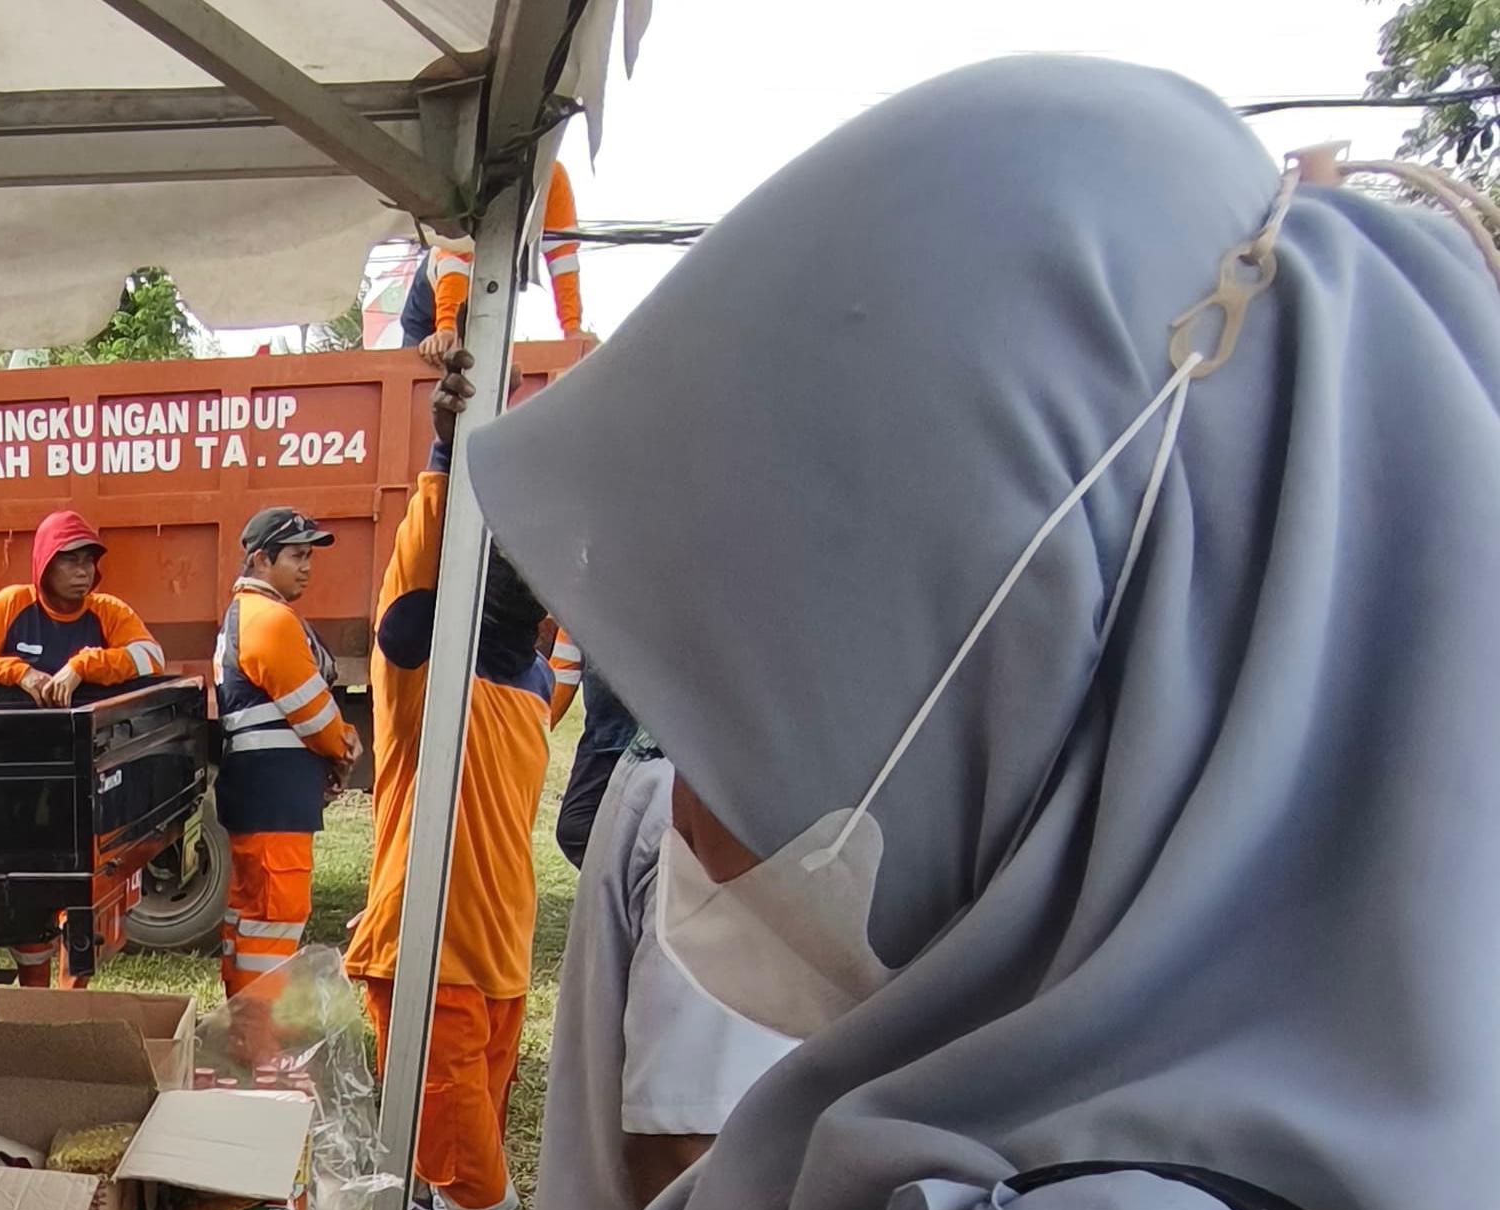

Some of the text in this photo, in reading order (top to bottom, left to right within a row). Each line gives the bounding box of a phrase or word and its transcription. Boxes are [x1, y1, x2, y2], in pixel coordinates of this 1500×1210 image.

[197, 395, 297, 433] HIDUP
[46, 438, 181, 477] BUMBU
[277, 430, 367, 467] 2024
